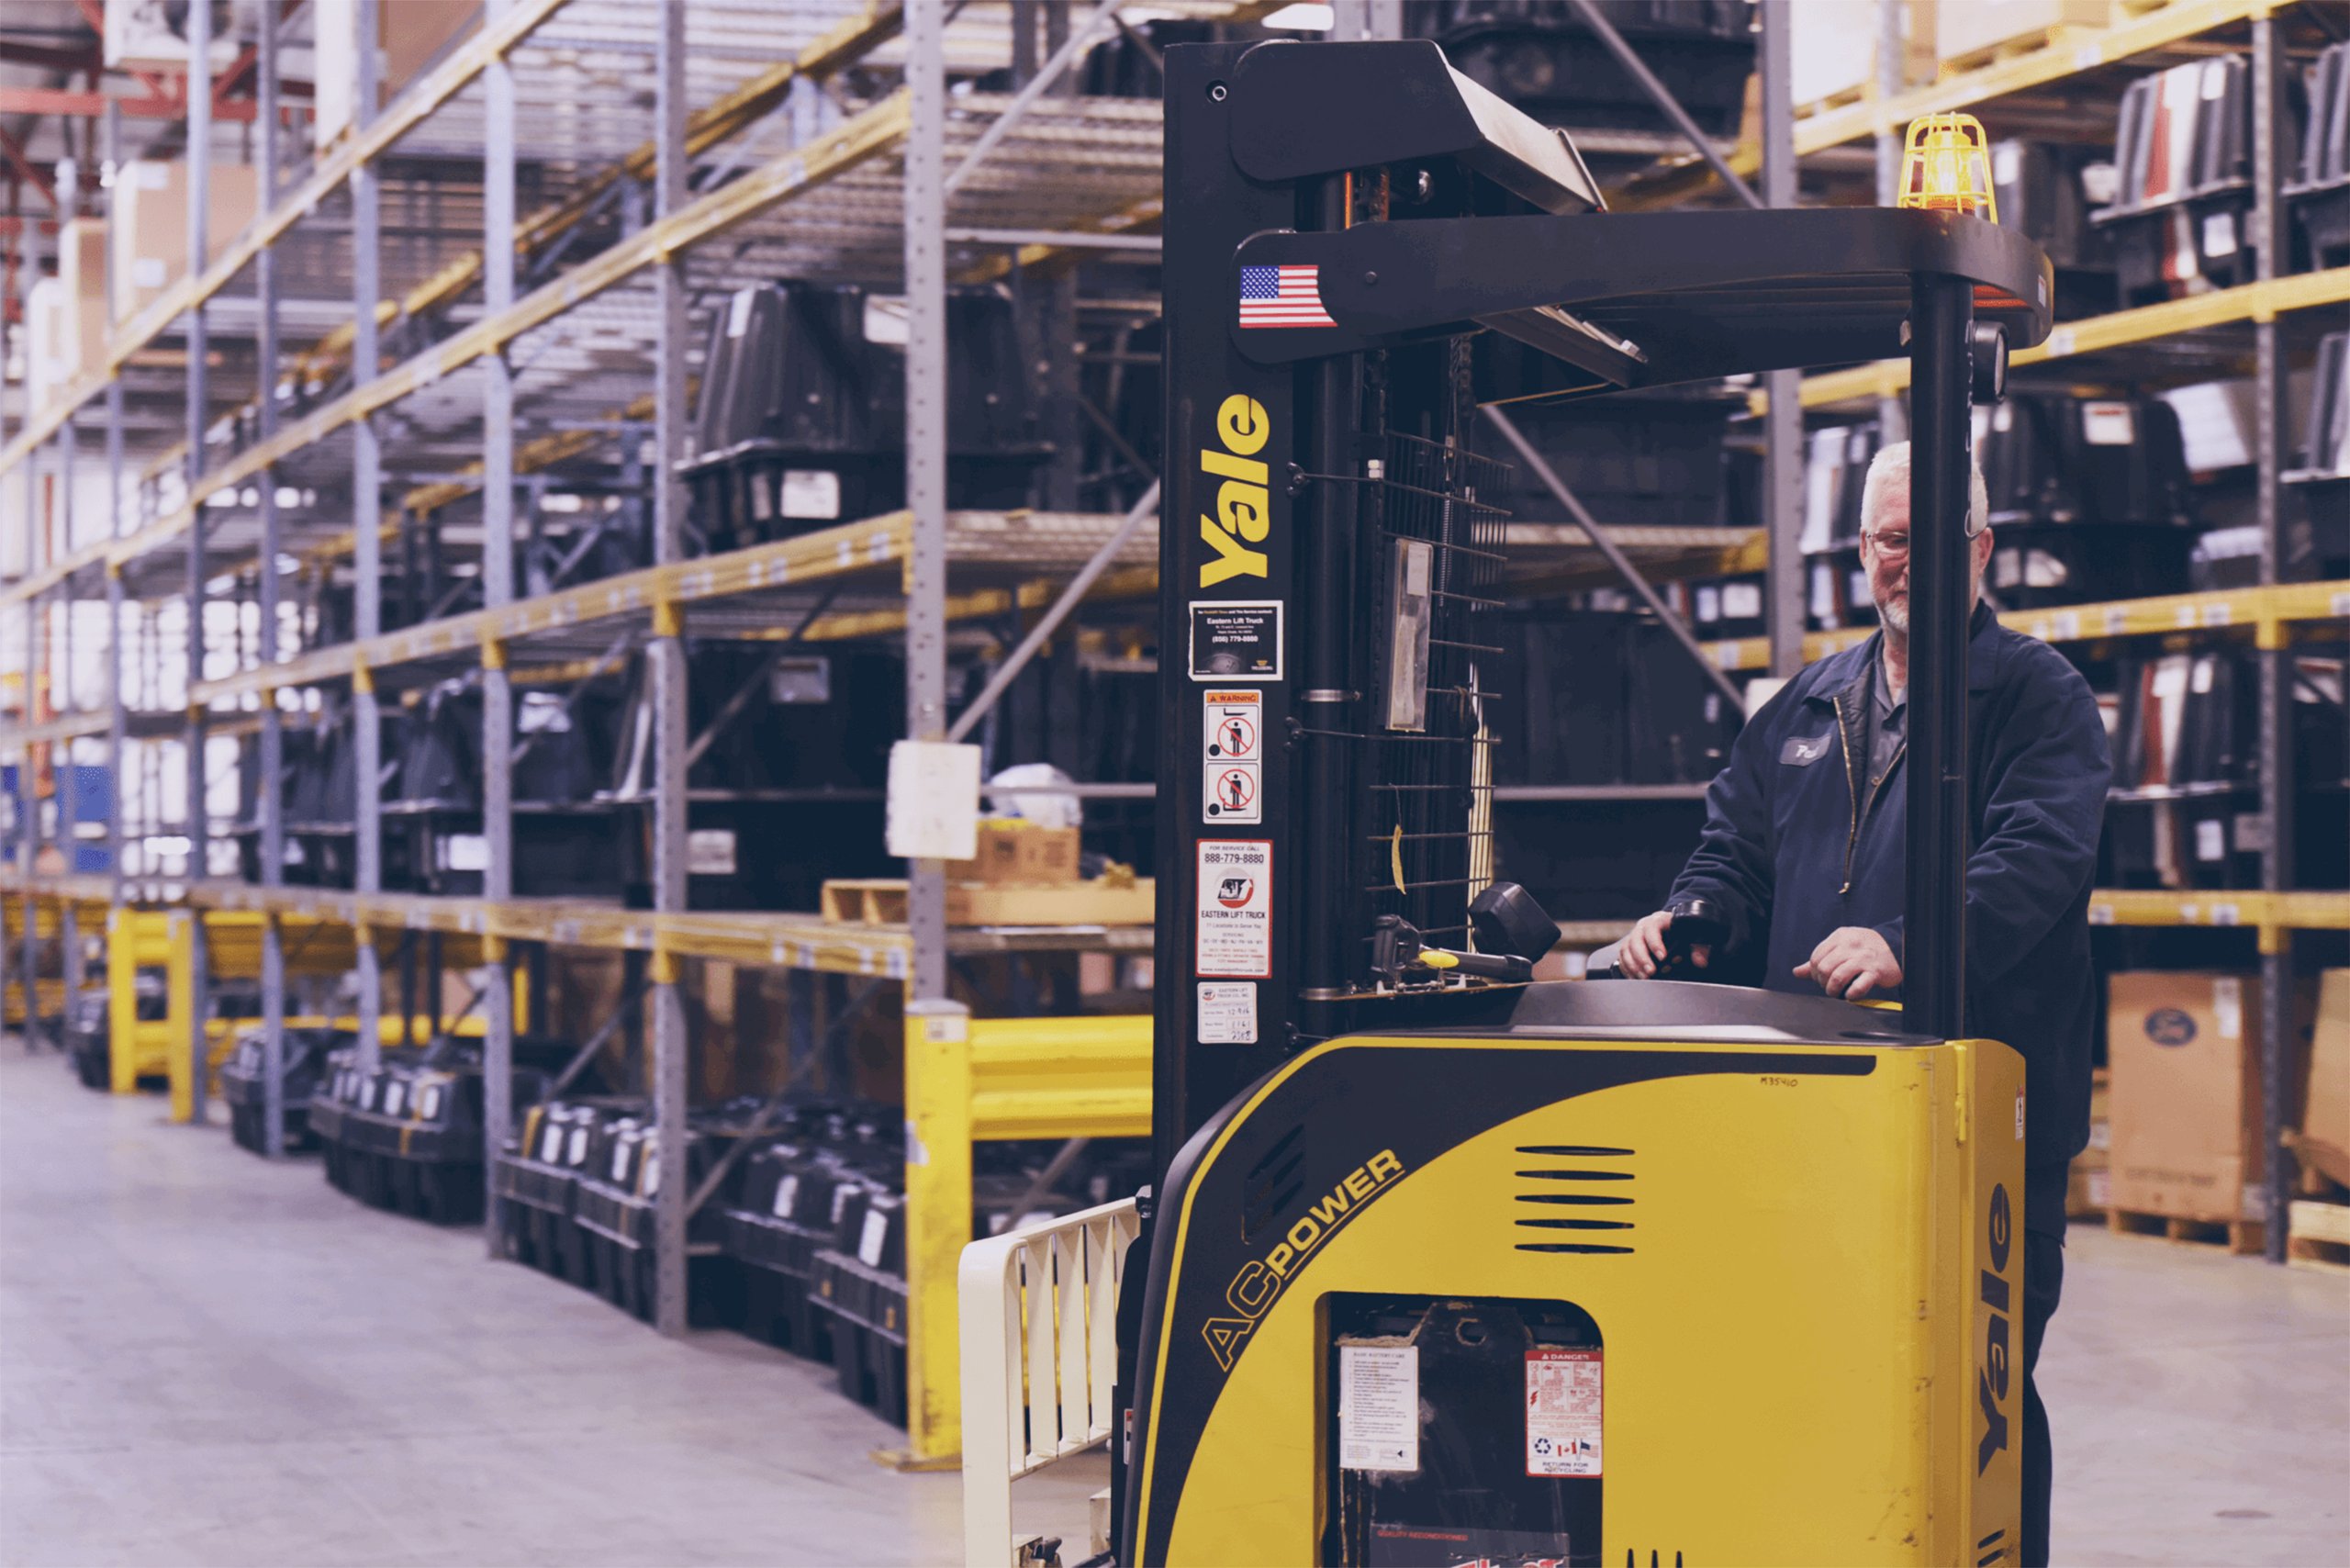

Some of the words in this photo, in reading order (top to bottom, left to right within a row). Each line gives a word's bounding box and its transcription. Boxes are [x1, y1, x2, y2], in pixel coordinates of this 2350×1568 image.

[1200, 394, 1270, 588] Yale
[1204, 853, 1264, 864] 888-779-8880
[1230, 911, 1244, 919] LIFT
[1246, 911, 1266, 919] TRUCK
[1978, 1182, 2010, 1478] Yale
